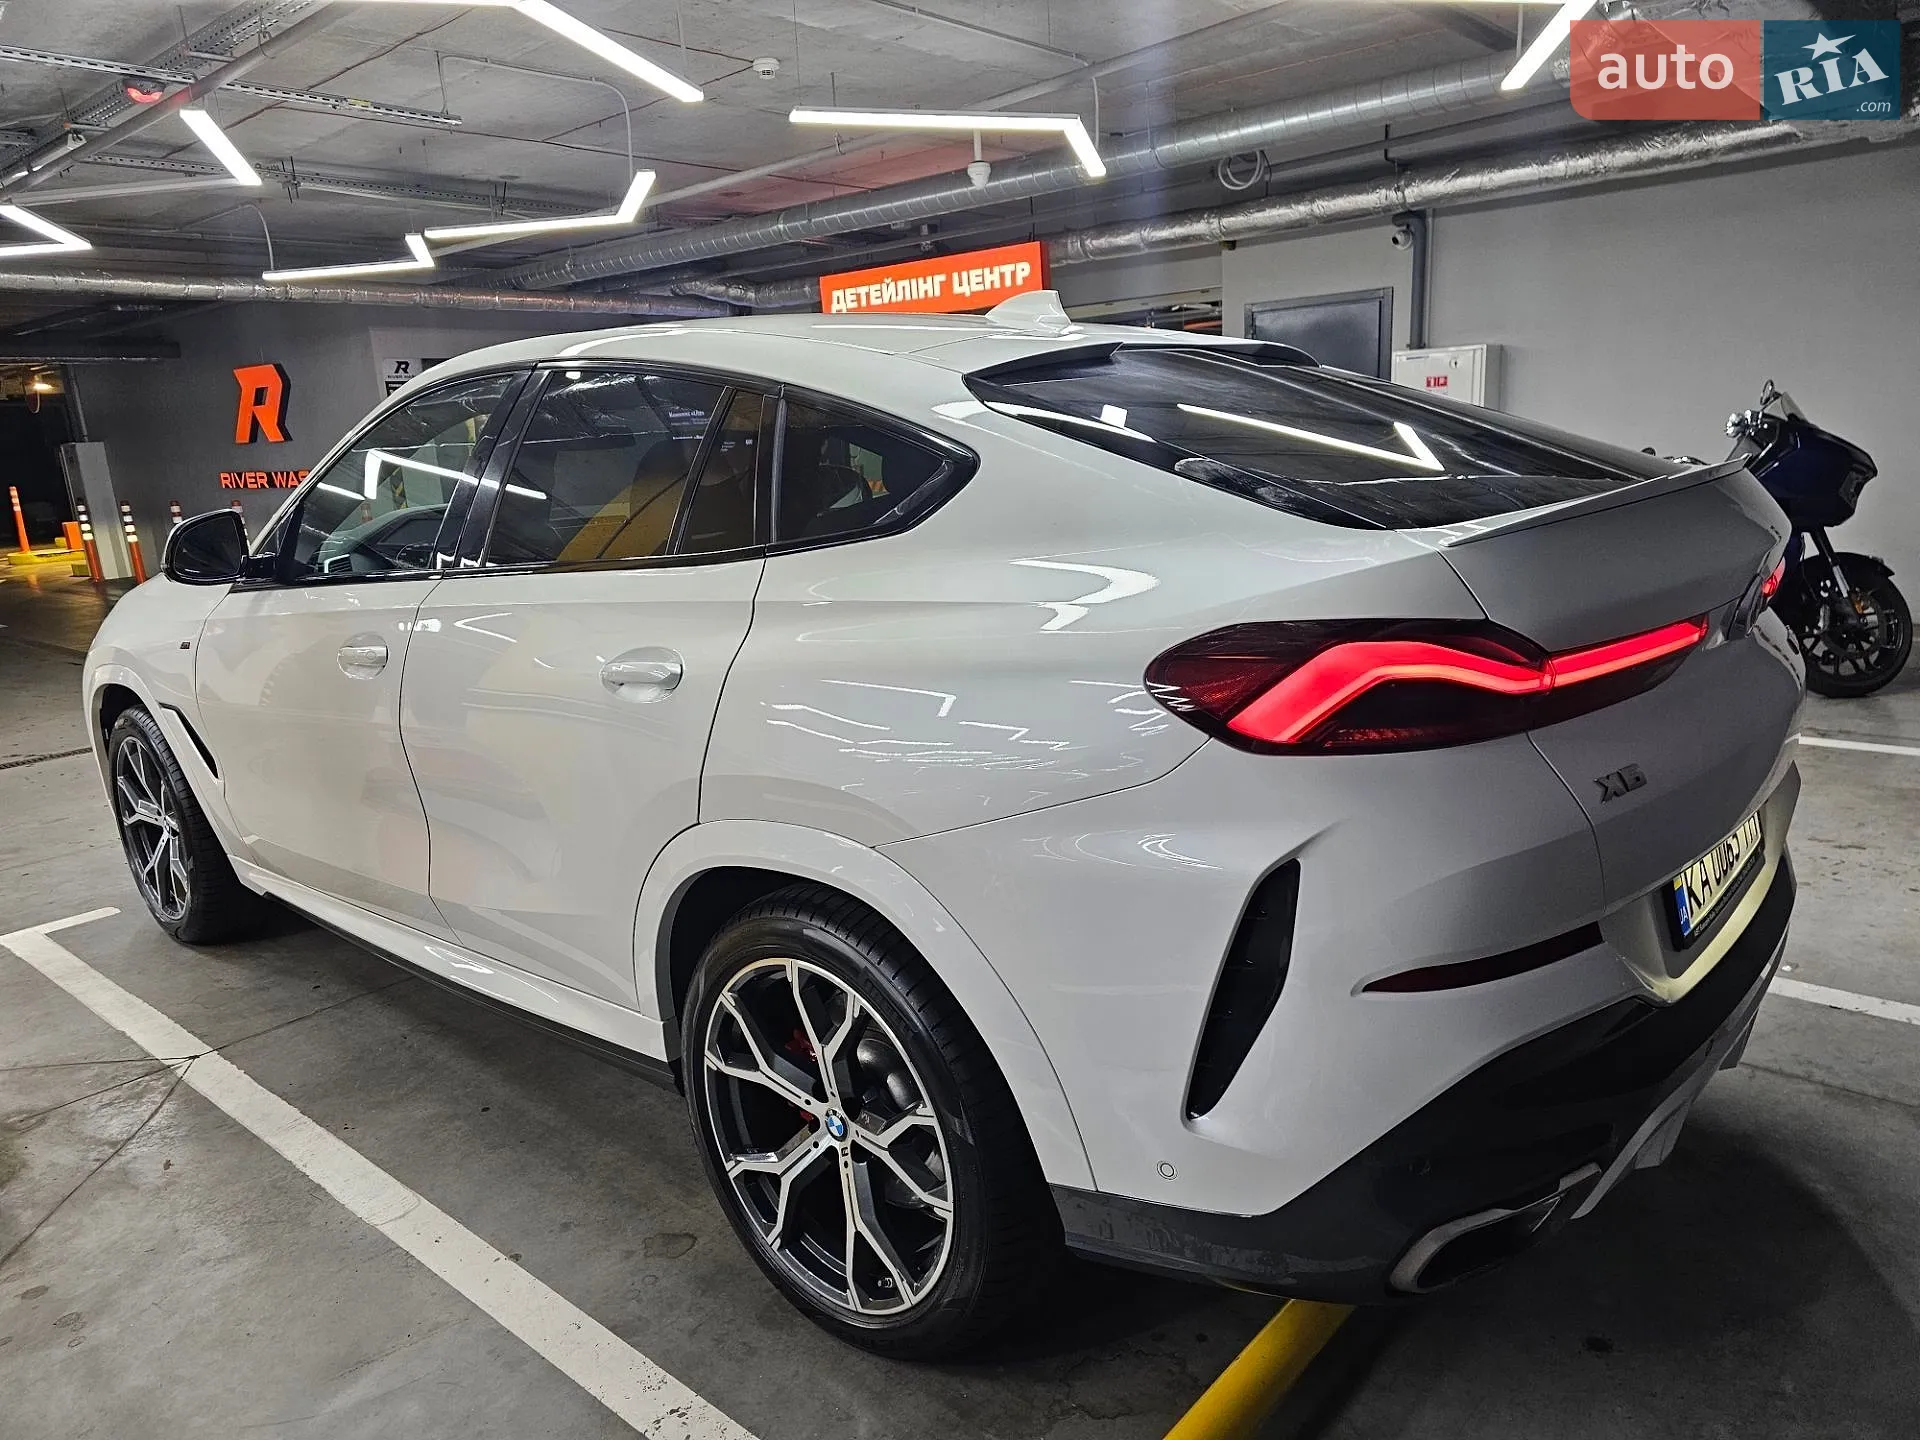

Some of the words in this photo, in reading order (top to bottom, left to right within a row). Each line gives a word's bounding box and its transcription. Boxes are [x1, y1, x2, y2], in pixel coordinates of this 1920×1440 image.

[831, 273, 946, 313] ДЕТЕЙЛІНГ
[952, 261, 1031, 298] ЦЕНТР
[232, 363, 292, 444] R
[220, 471, 269, 488] RIVER
[1593, 763, 1648, 804] X6
